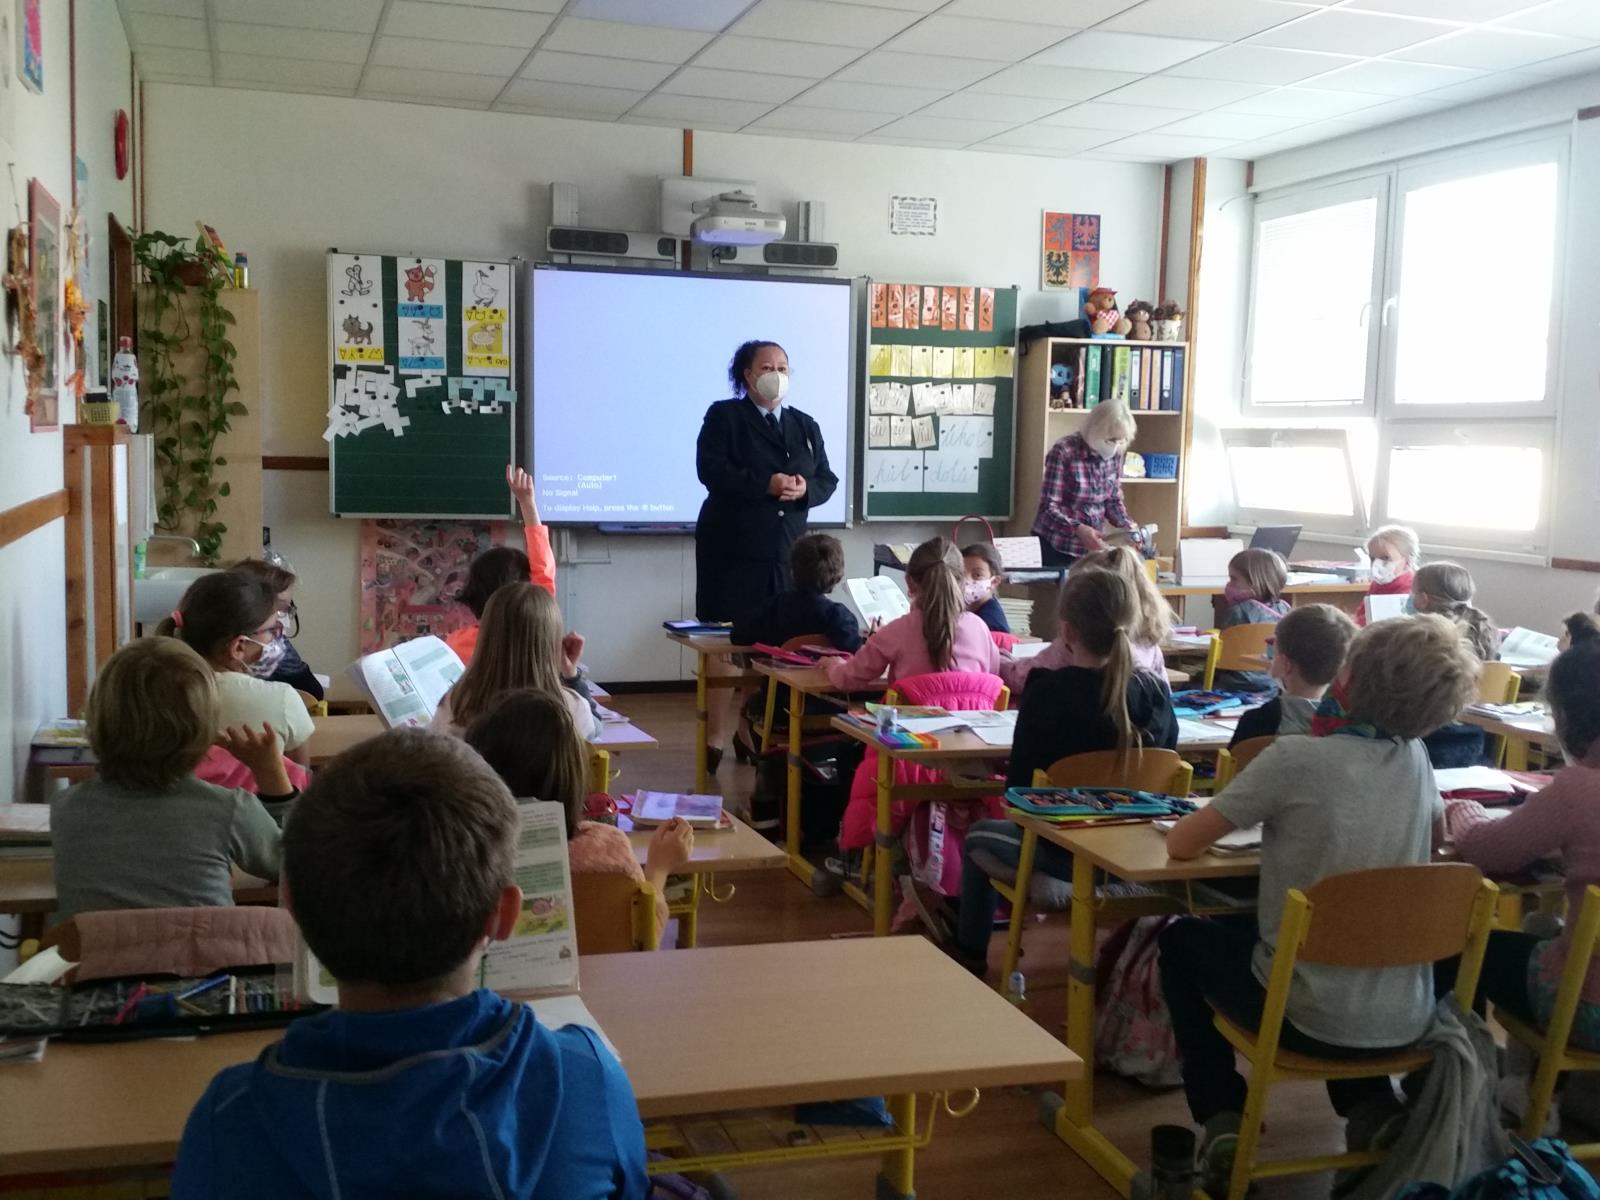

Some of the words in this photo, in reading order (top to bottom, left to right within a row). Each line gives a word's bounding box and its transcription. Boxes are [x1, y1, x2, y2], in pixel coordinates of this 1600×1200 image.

[577, 481, 602, 489] (Auto)
[554, 504, 580, 512] display
[603, 504, 625, 512] press
